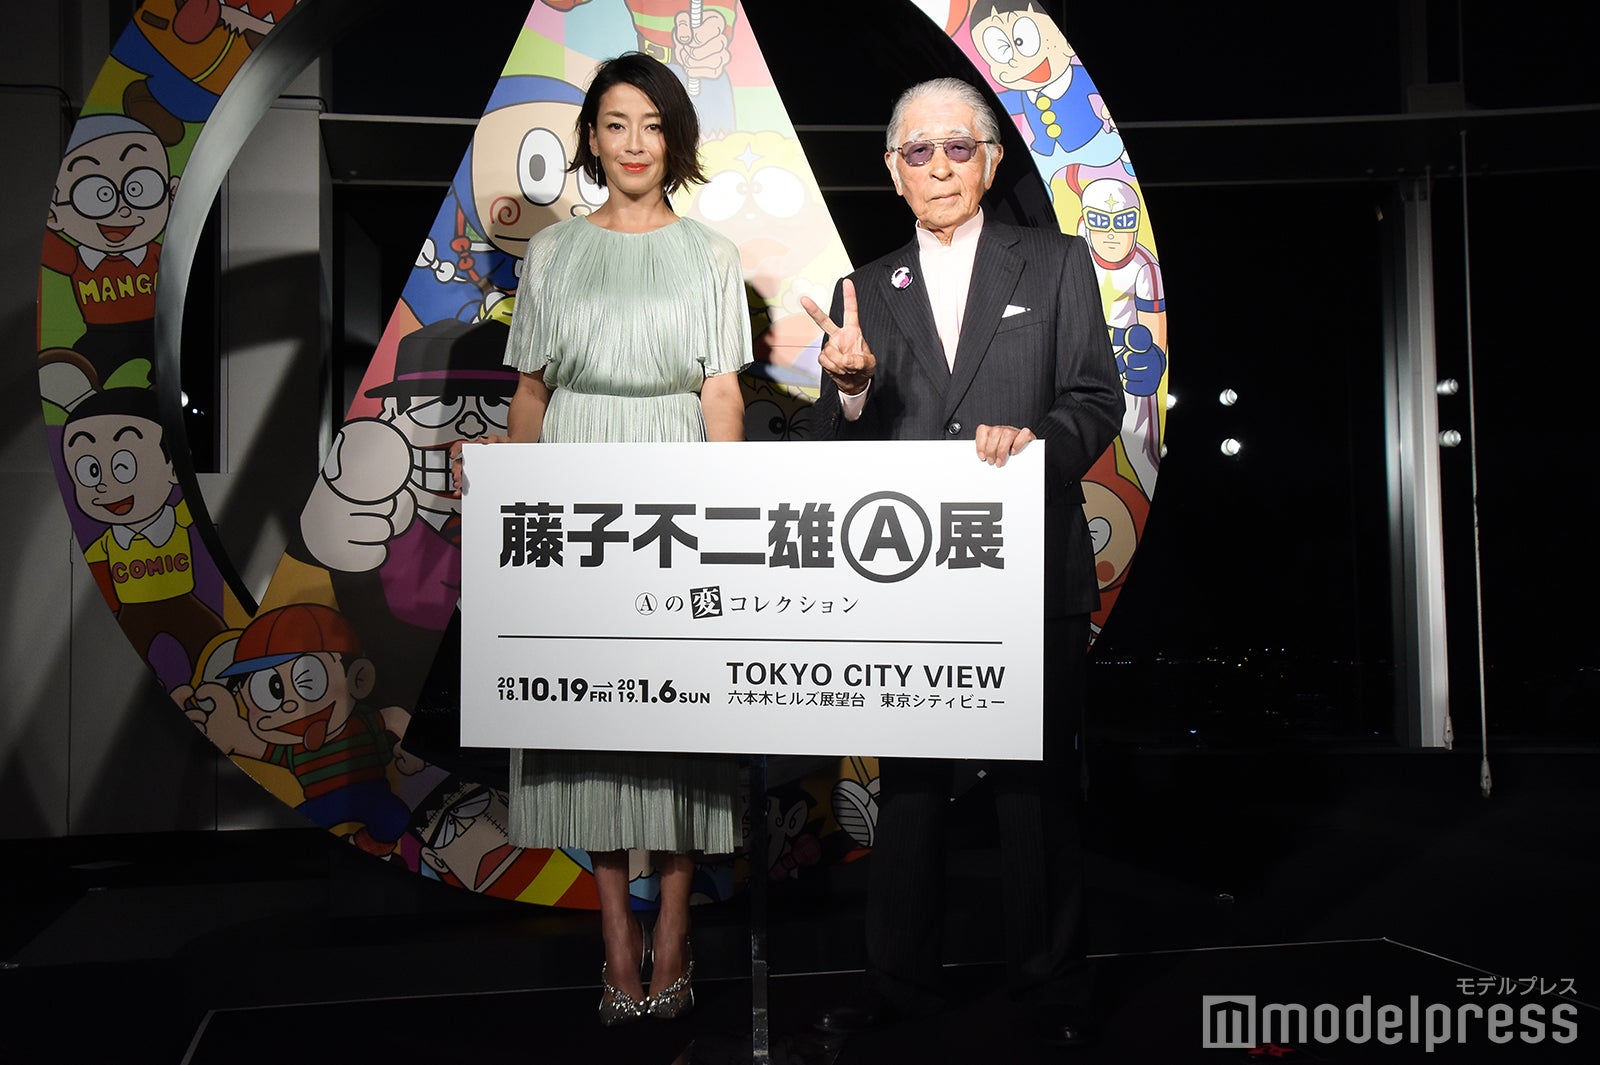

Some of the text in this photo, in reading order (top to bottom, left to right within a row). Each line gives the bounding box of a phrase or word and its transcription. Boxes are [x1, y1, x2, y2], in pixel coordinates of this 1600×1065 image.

[112, 553, 190, 584] COMIC
[726, 661, 1006, 689] TOKYO CITY VIEW
[727, 690, 1006, 709] 六本木ヒルズ展望台 東京シティビュー
